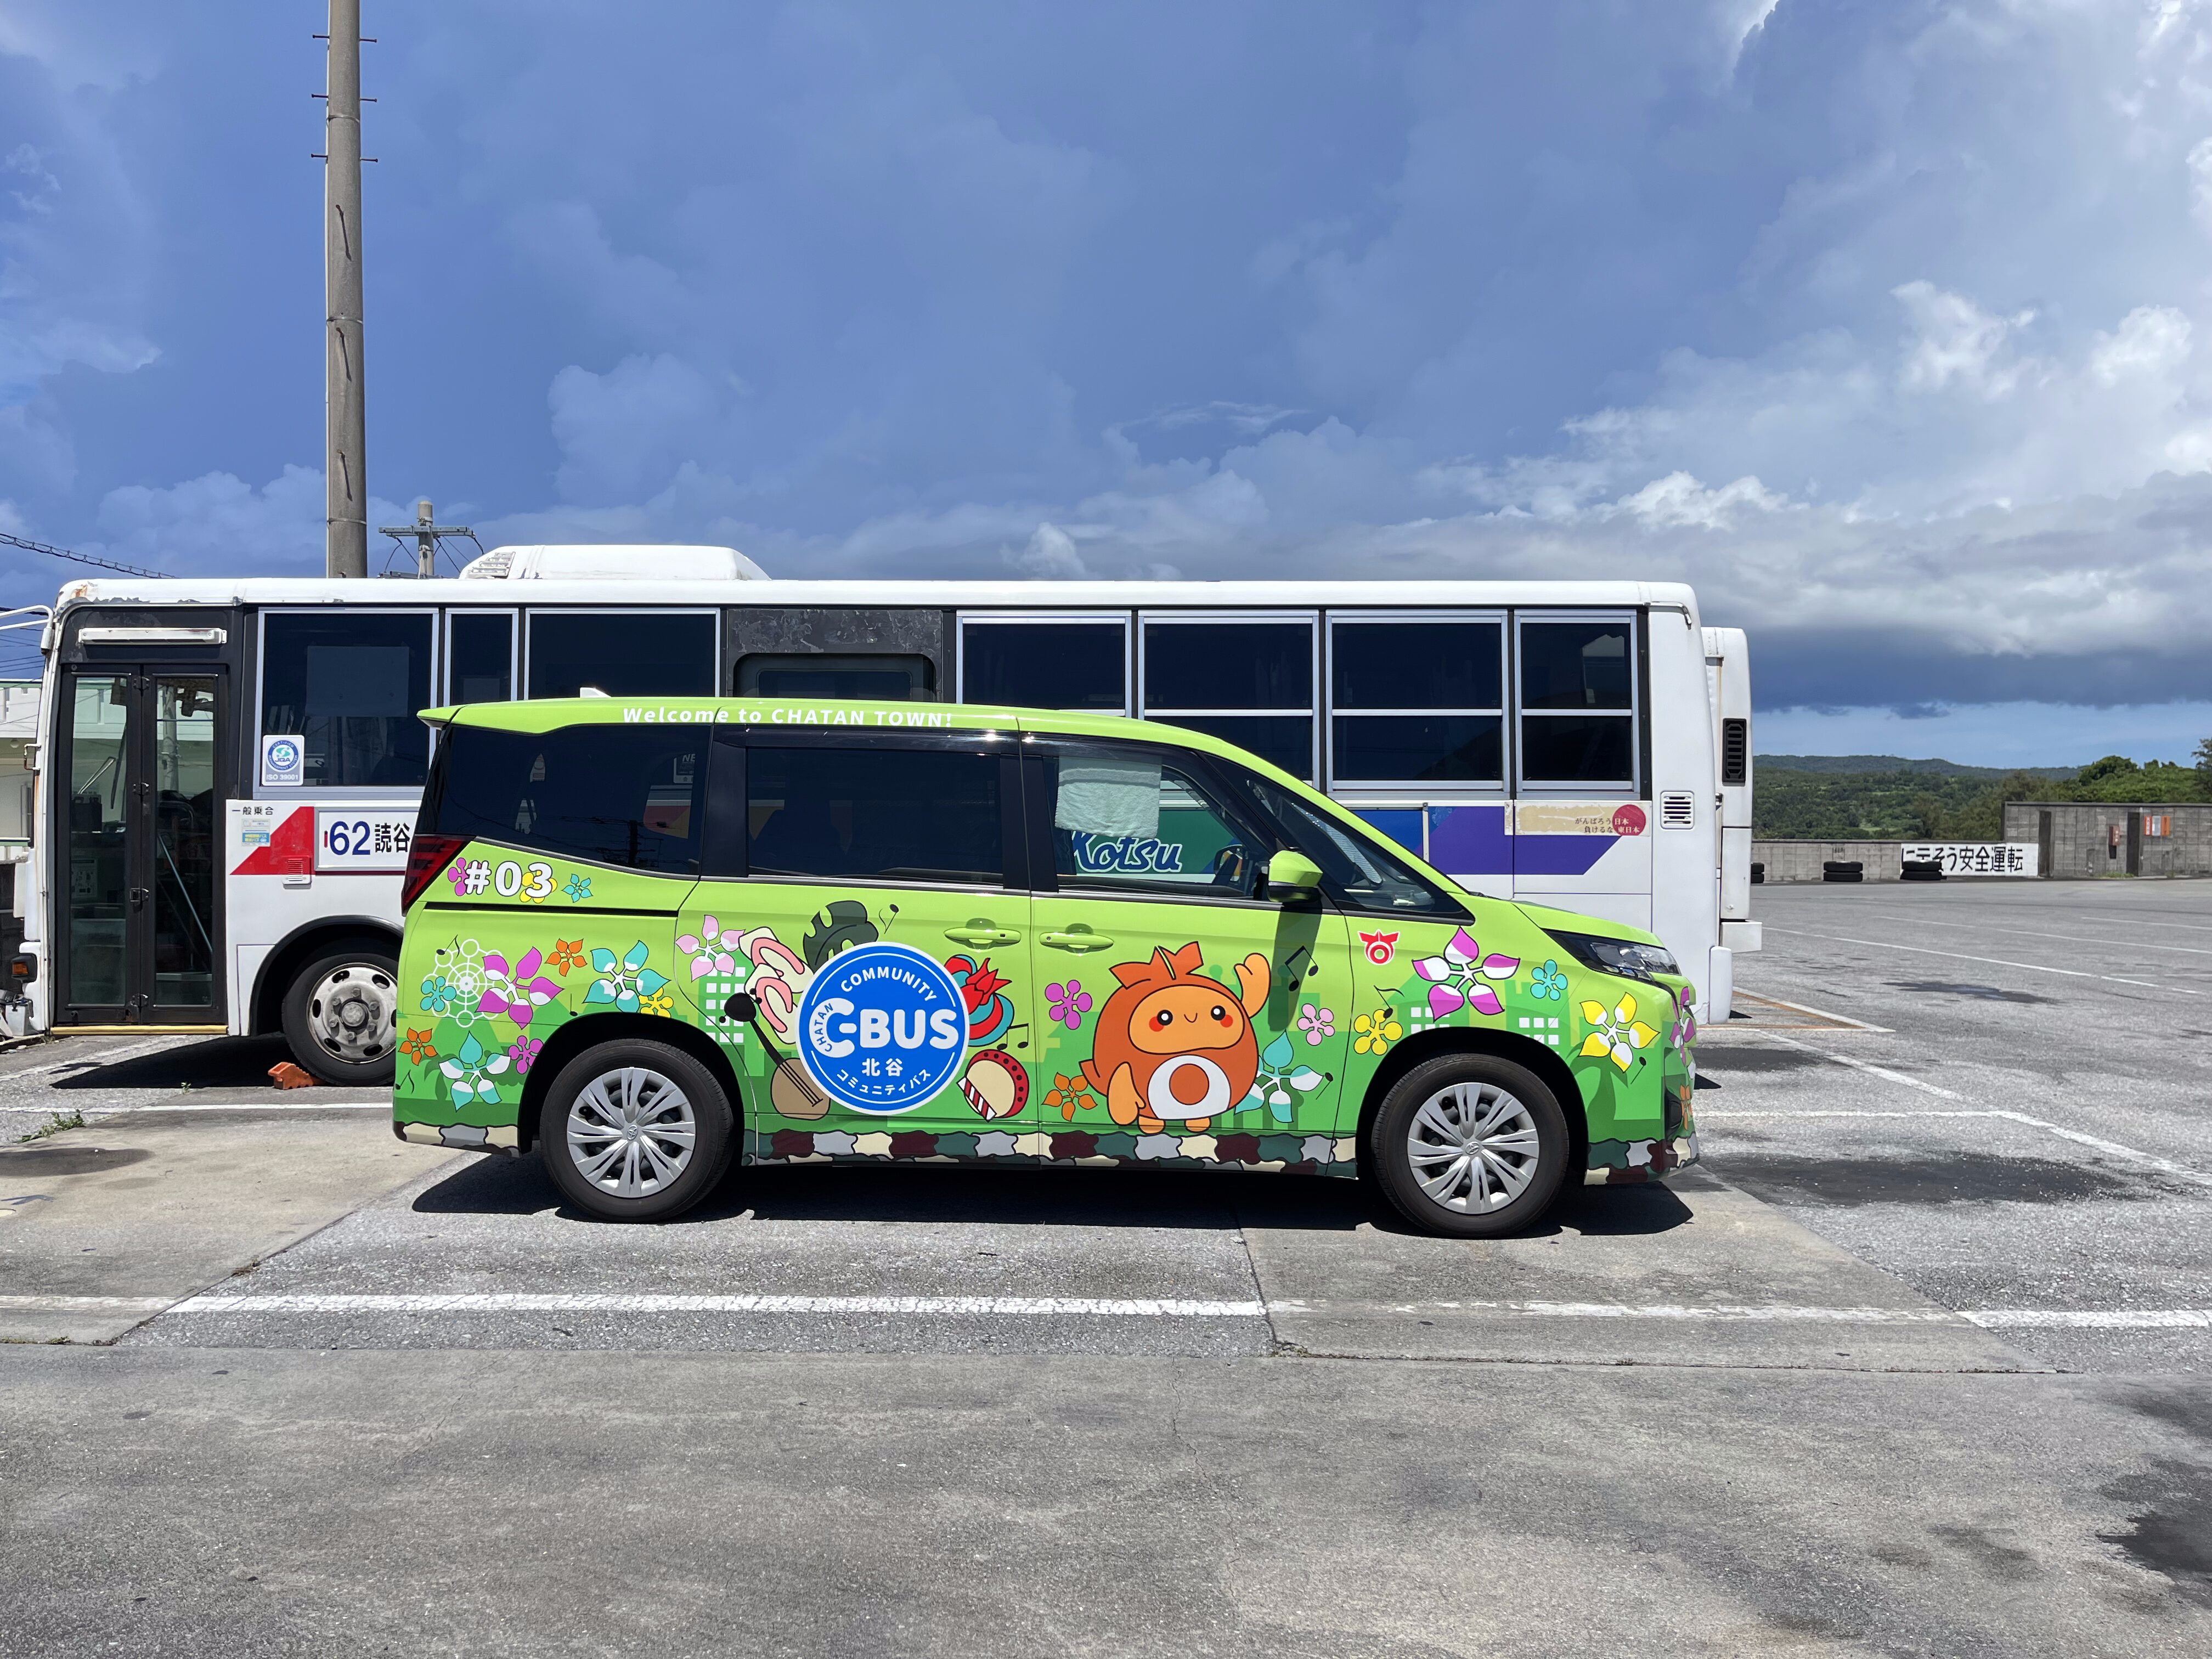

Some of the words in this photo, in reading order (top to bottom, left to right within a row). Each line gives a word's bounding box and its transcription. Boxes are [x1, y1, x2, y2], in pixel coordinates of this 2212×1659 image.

[623, 707, 729, 723] Welcome
[739, 708, 761, 723] to
[771, 708, 864, 725] CHATAN
[874, 711, 951, 727] TOWN!
[232, 806, 274, 815] 一般乗合
[329, 821, 371, 855] 62
[374, 822, 410, 853] 読谷
[1071, 831, 1183, 873] Kotsu
[464, 860, 554, 899] #03
[840, 966, 937, 1002] COMMUNITY
[814, 1003, 834, 1053] CHATAN
[837, 1069, 931, 1096] コミュニティバス
[862, 1058, 903, 1077] 北谷
